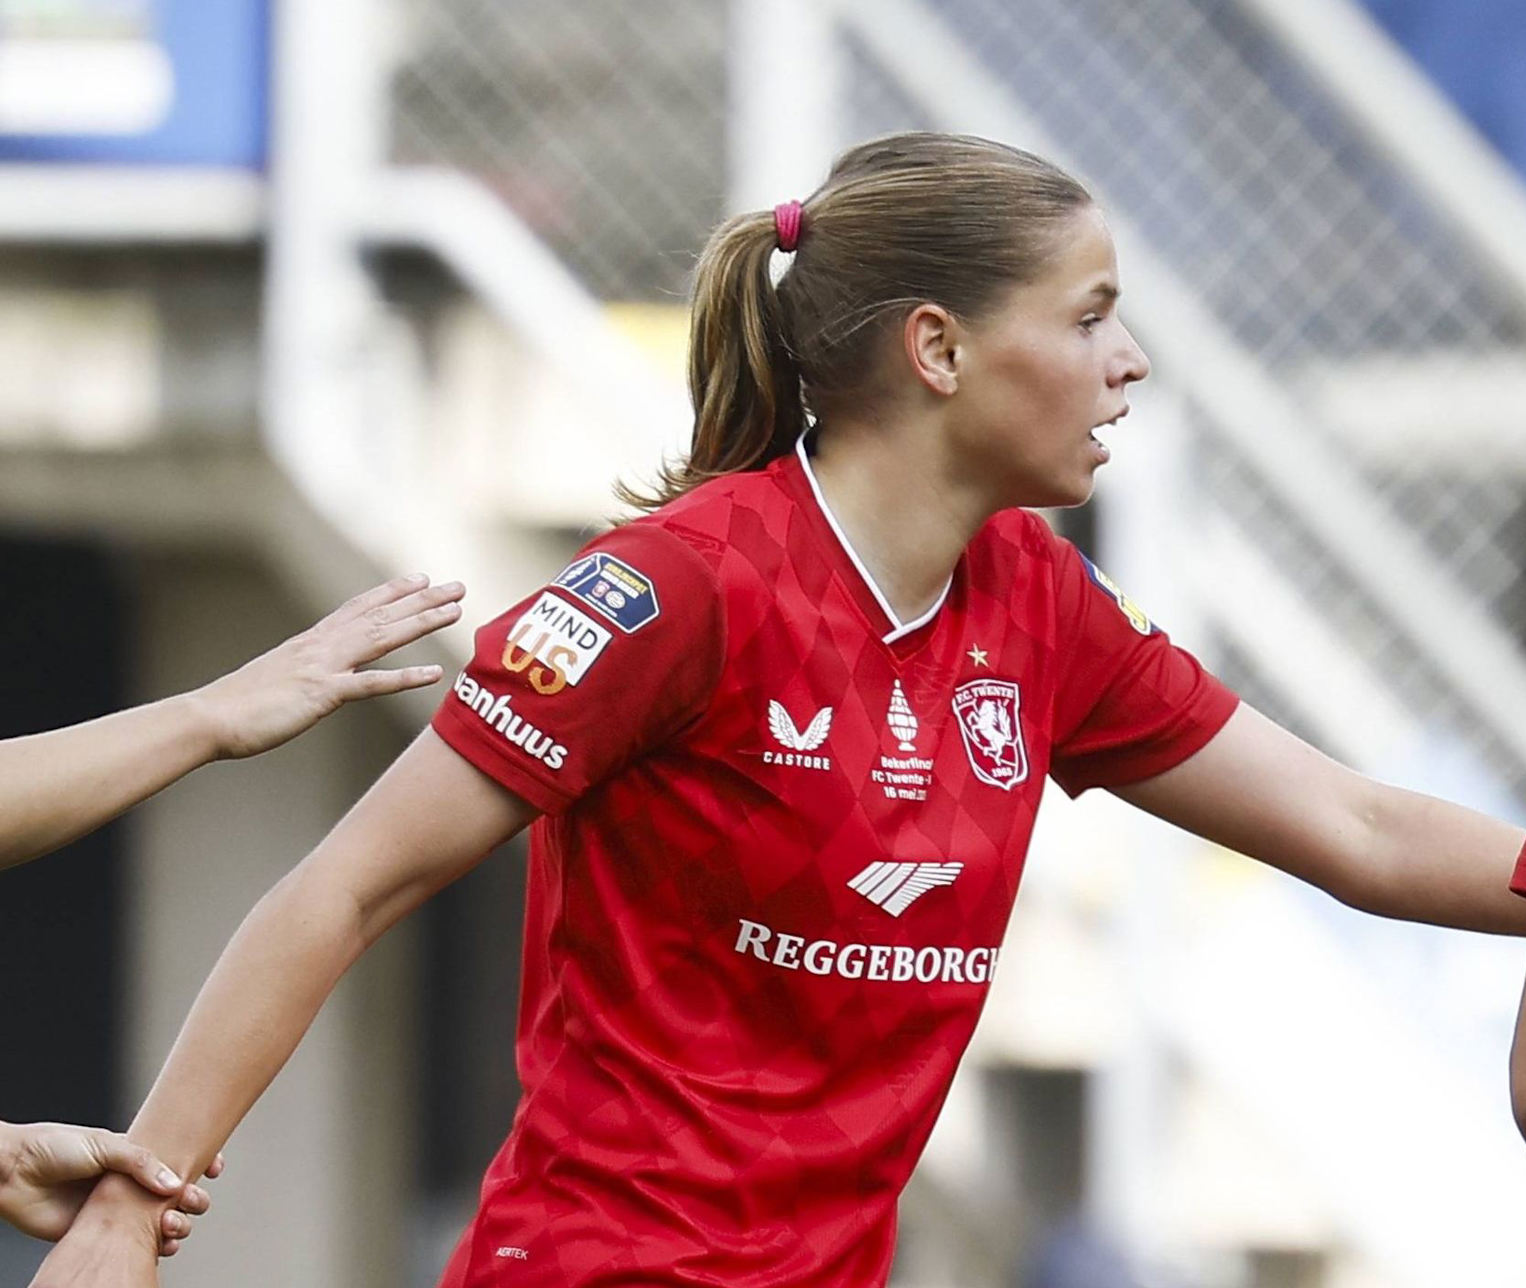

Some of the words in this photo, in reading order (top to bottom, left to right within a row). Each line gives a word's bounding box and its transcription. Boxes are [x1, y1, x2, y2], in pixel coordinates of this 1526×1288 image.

[533, 598, 600, 652] MIND
[501, 622, 579, 697] US
[762, 751, 831, 771] CASTORE
